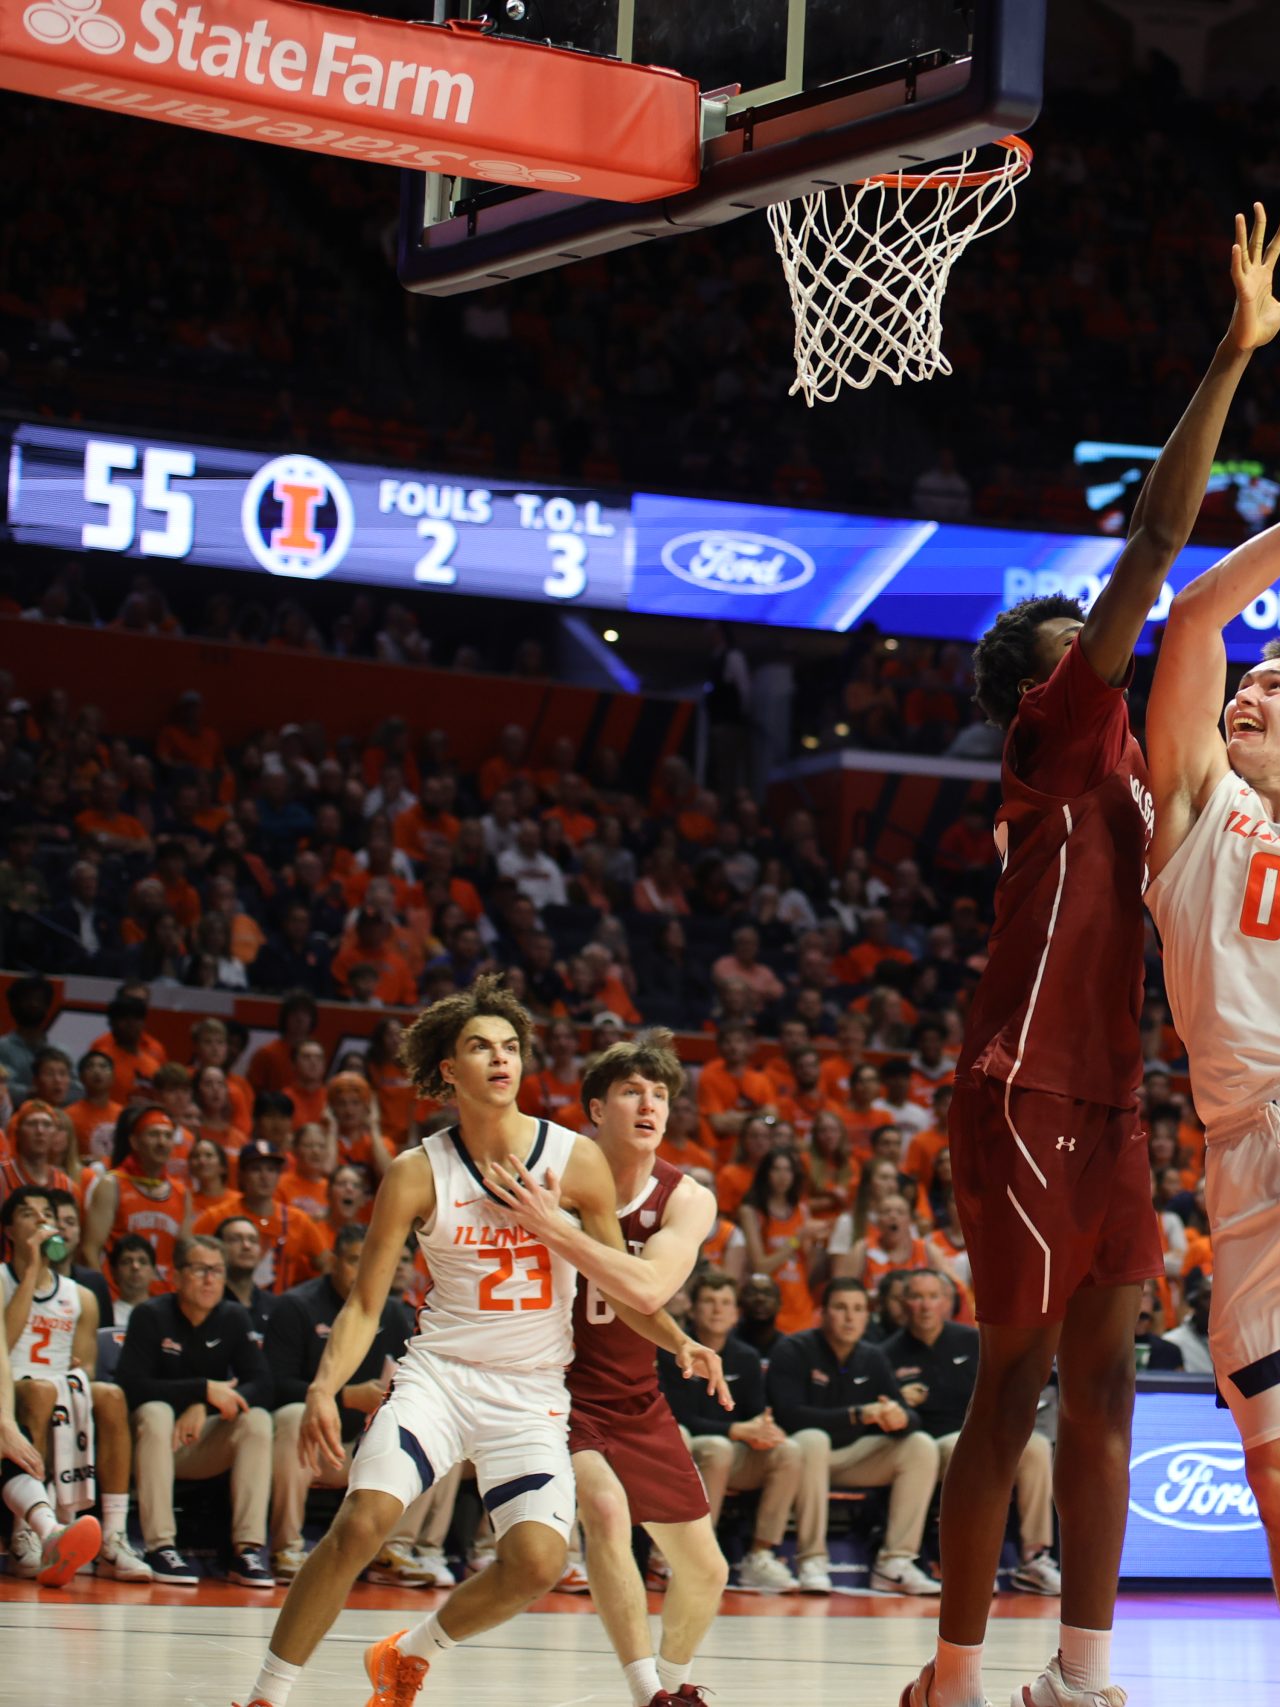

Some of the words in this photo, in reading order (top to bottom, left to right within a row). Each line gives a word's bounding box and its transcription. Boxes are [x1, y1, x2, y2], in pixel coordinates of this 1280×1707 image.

[82, 440, 195, 558] 55
[379, 479, 493, 524] FOULS
[515, 493, 616, 537] T.O.L.
[415, 519, 457, 585] 2
[544, 533, 588, 599] 3
[689, 536, 786, 586] Ford
[453, 1224, 537, 1248] ILLIN
[477, 1244, 552, 1311] 23
[30, 1327, 51, 1366] 2
